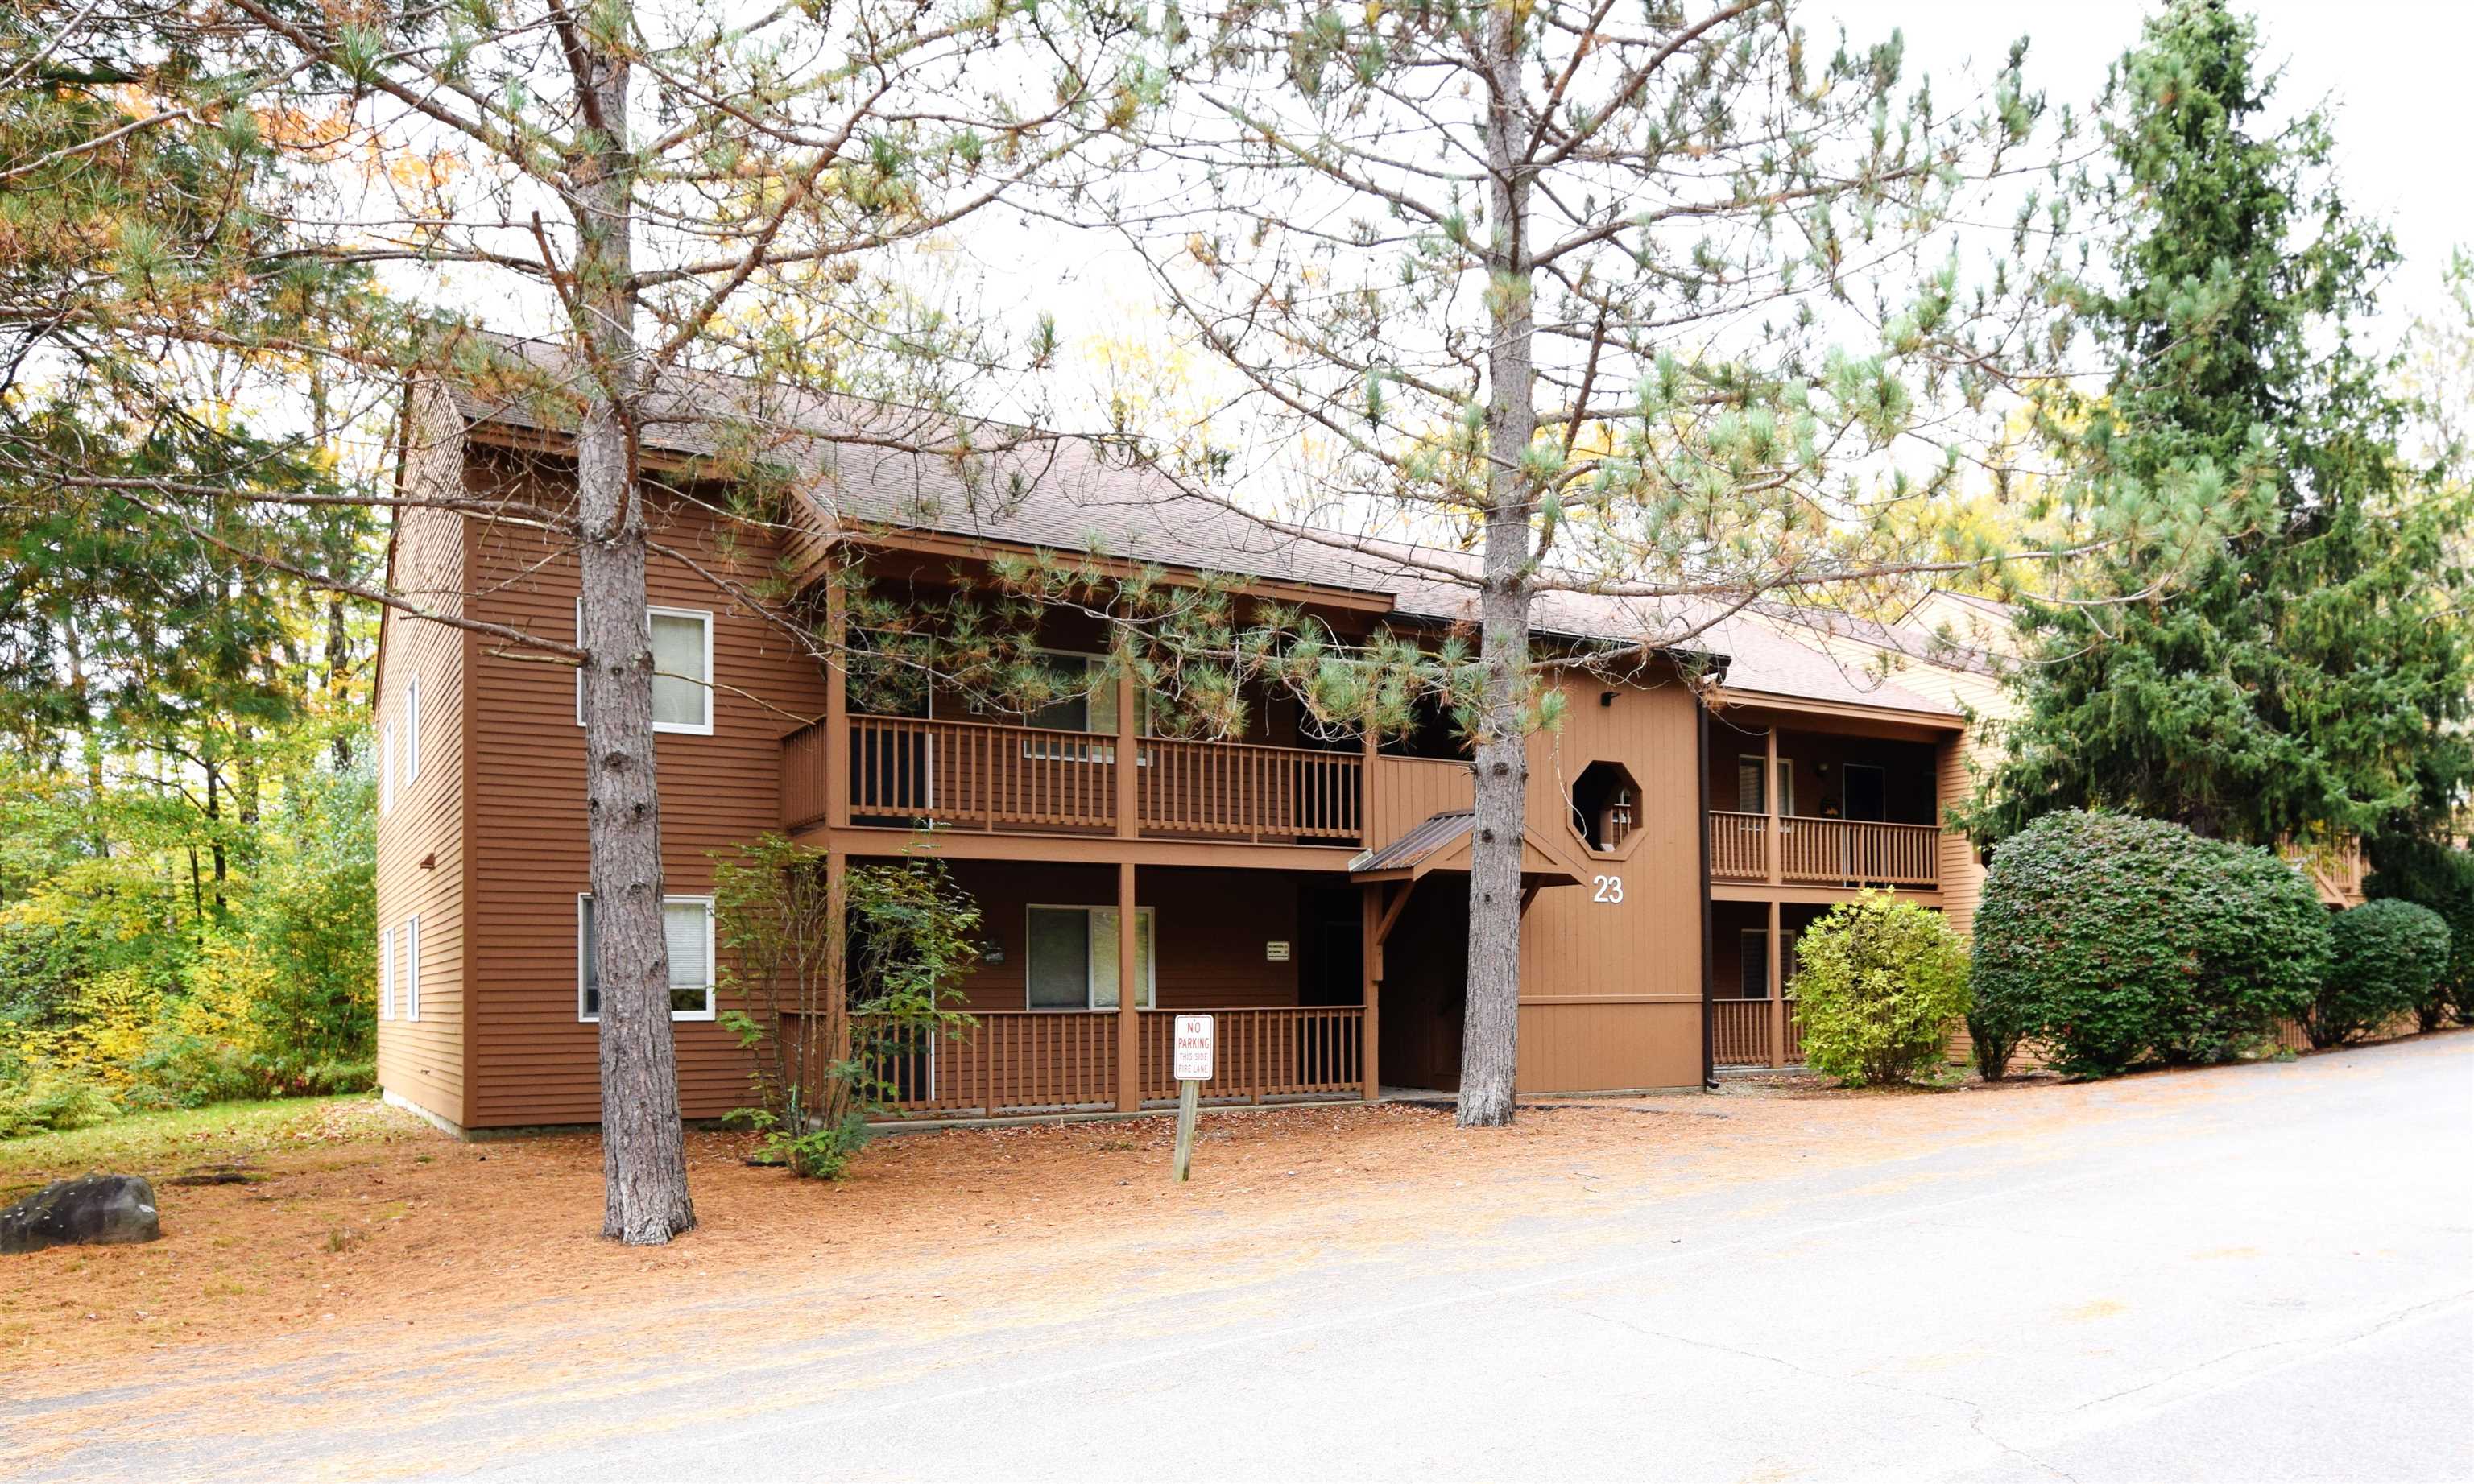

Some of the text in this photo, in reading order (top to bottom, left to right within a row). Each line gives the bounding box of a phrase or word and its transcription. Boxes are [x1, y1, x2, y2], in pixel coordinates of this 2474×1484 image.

[1594, 875, 1624, 903] 23
[1187, 1022, 1201, 1034] NO
[1178, 1037, 1210, 1049] PARKING
[1179, 1052, 1208, 1061] THIS SIDE
[1178, 1064, 1209, 1073] FIRE LANE
